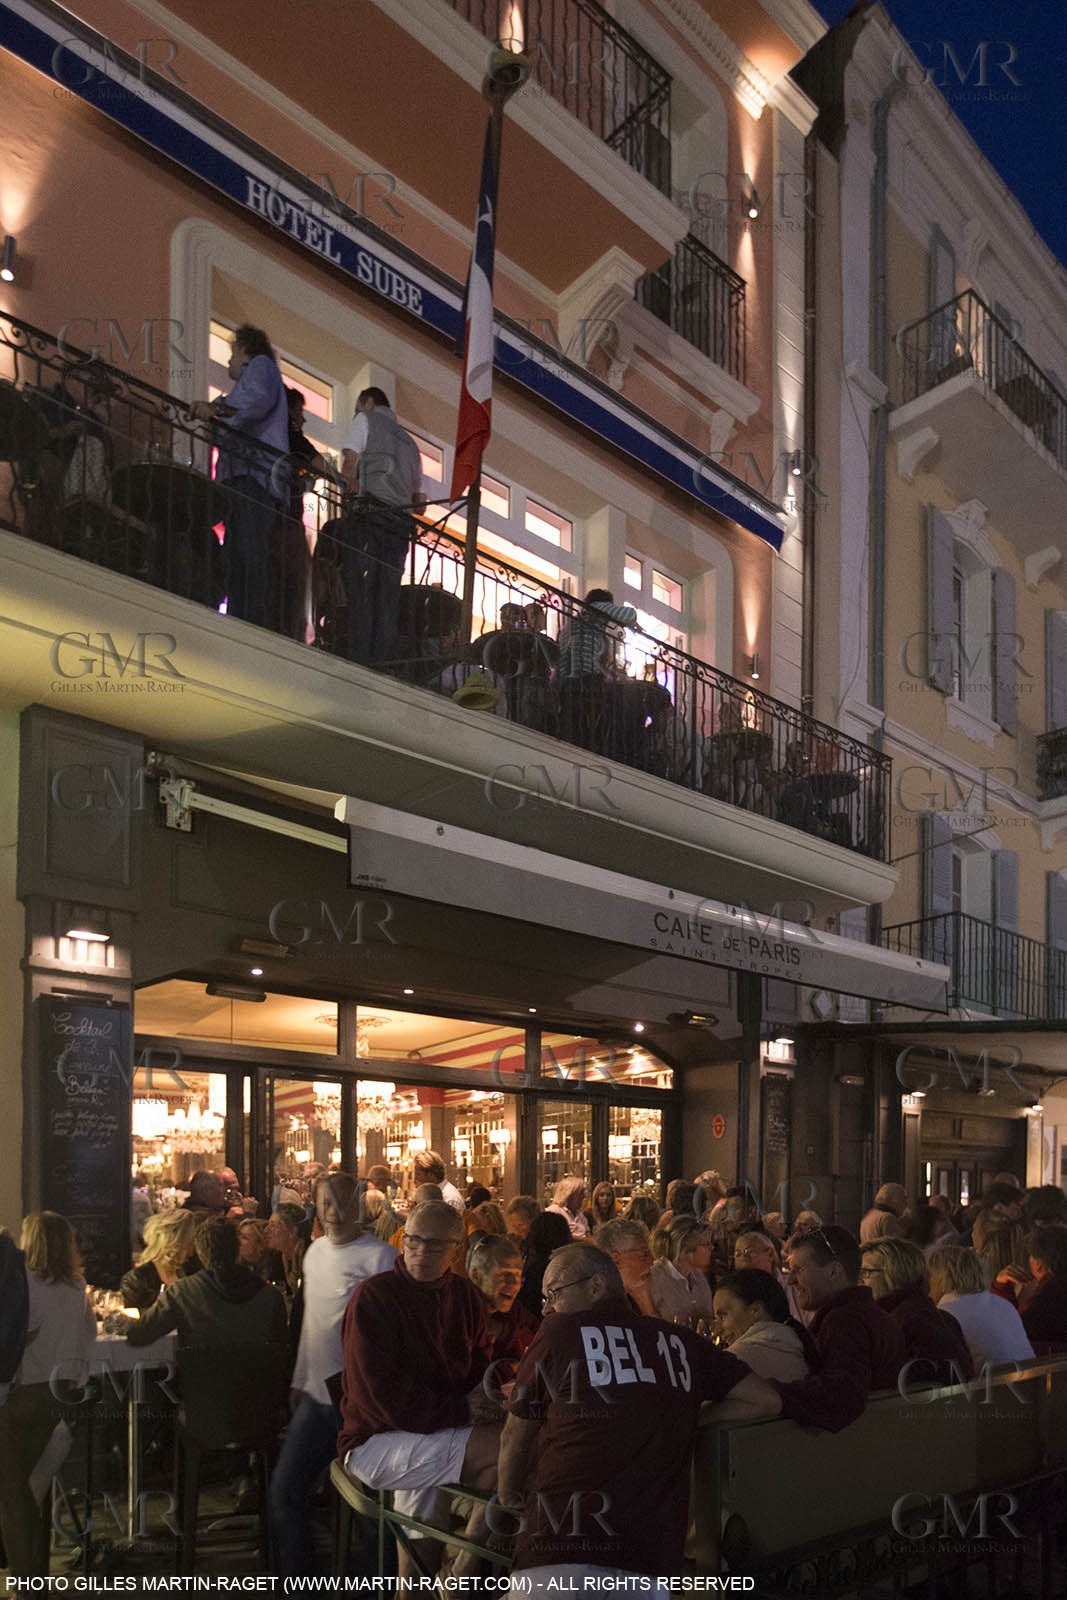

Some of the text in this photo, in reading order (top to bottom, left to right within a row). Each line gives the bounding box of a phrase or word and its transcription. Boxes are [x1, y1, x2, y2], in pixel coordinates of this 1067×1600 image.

[356, 251, 423, 316] SUBE
[722, 937, 741, 952] DE
[749, 937, 801, 966] PARIS
[580, 1324, 692, 1392] BEL 13
